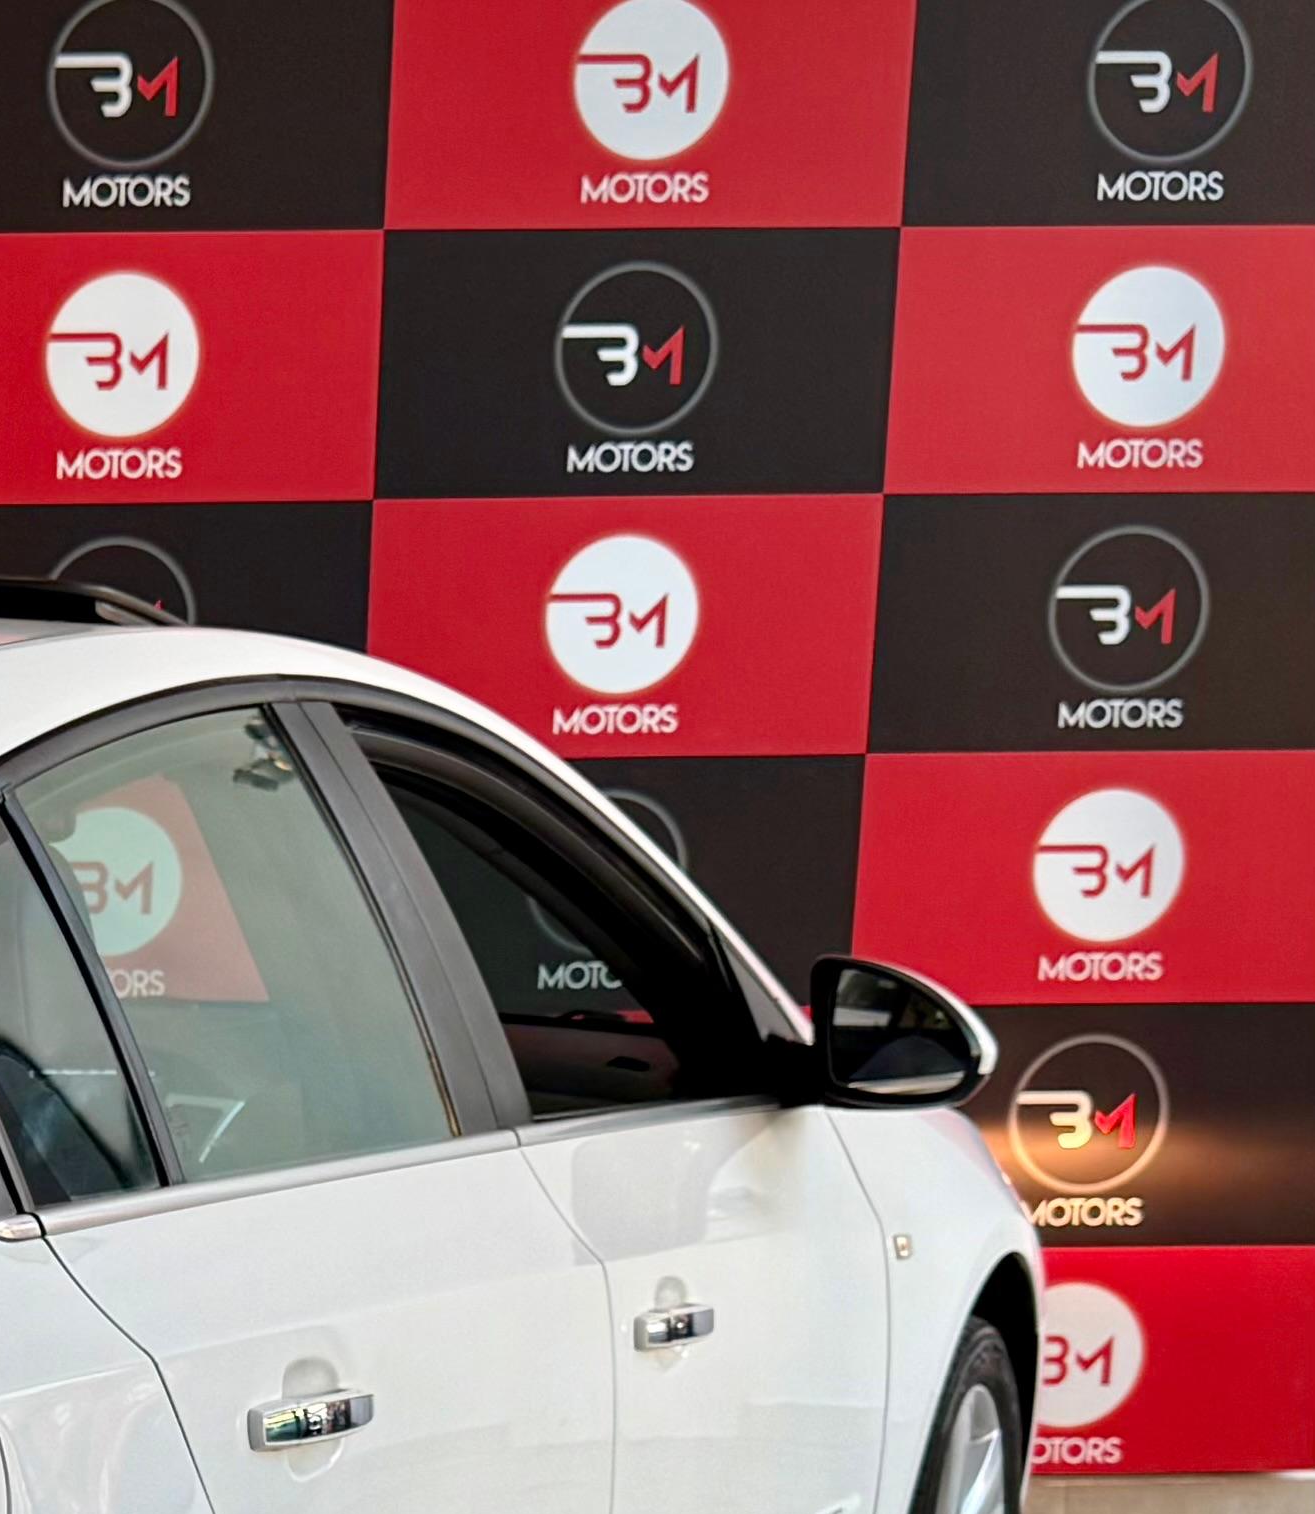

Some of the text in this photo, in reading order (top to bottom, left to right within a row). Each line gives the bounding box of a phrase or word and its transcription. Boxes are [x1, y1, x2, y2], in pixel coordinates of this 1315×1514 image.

[54, 52, 178, 119] BM
[578, 53, 700, 113] BM
[1096, 50, 1218, 113] BM
[63, 176, 190, 207] MOTORS
[581, 173, 708, 203] MOTORS
[1097, 171, 1223, 200] MOTORS
[49, 331, 169, 391] BM
[563, 323, 684, 386] BM
[1077, 323, 1195, 381] BM
[57, 448, 182, 479] MOTORS
[567, 442, 693, 472] MOTORS
[1077, 439, 1202, 468] MOTORS
[549, 592, 669, 650] BM
[1056, 584, 1175, 645] BM
[553, 704, 678, 734] MOTORS
[1057, 698, 1183, 729] MOTORS
[1038, 843, 1156, 898] BM
[1038, 952, 1162, 981] MOTORS
[1018, 1090, 1136, 1150] BM
[1043, 1335, 1115, 1386] BM
[1032, 1437, 1122, 1465] OTORS
